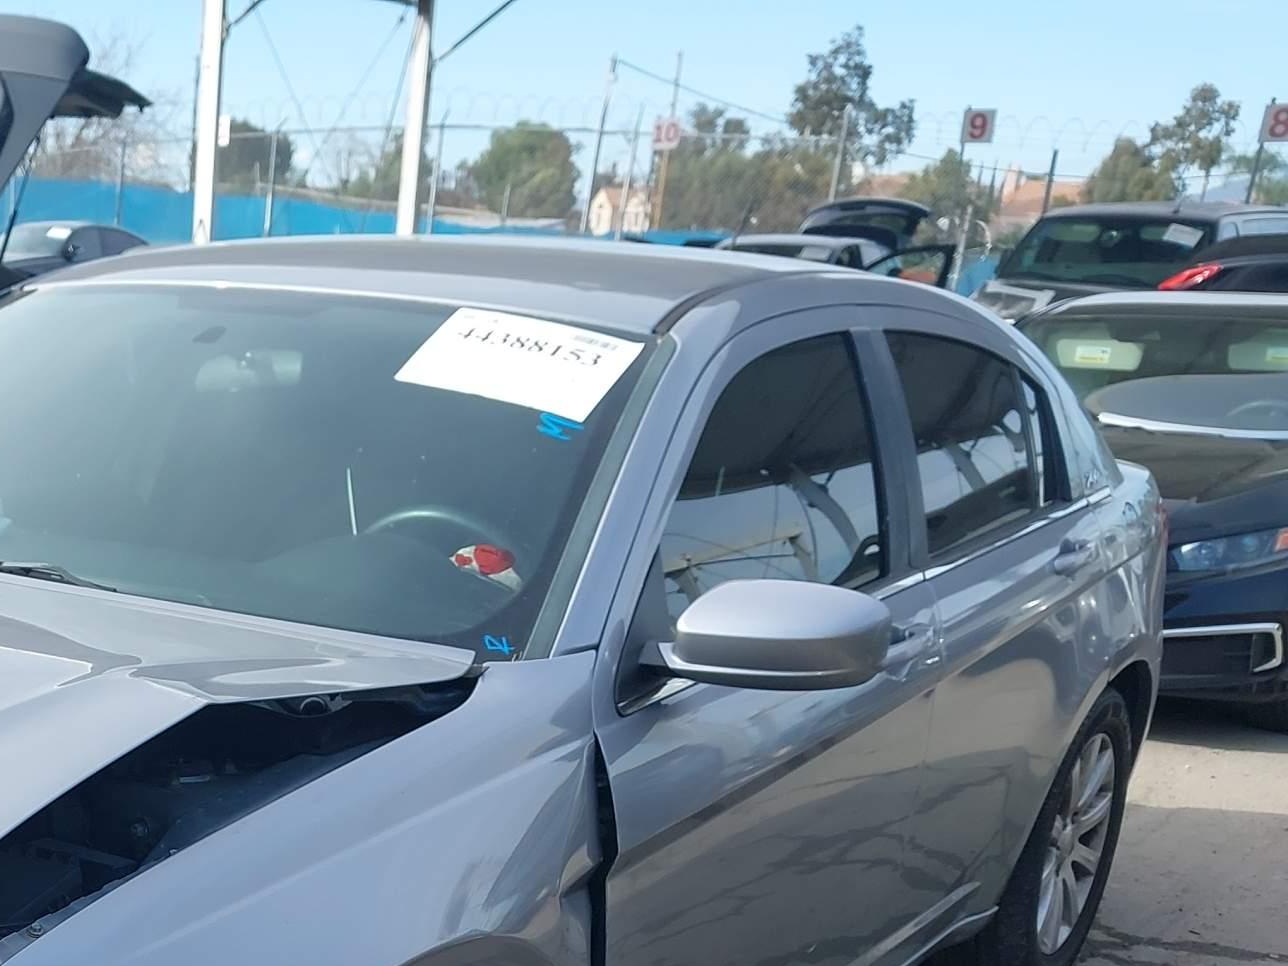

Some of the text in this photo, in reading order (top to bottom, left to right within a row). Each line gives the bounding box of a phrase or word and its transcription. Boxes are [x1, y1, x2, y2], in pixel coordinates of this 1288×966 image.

[652, 121, 679, 144] 10
[968, 111, 988, 140] 9
[1268, 107, 1288, 138] 8
[458, 327, 602, 366] 44388153
